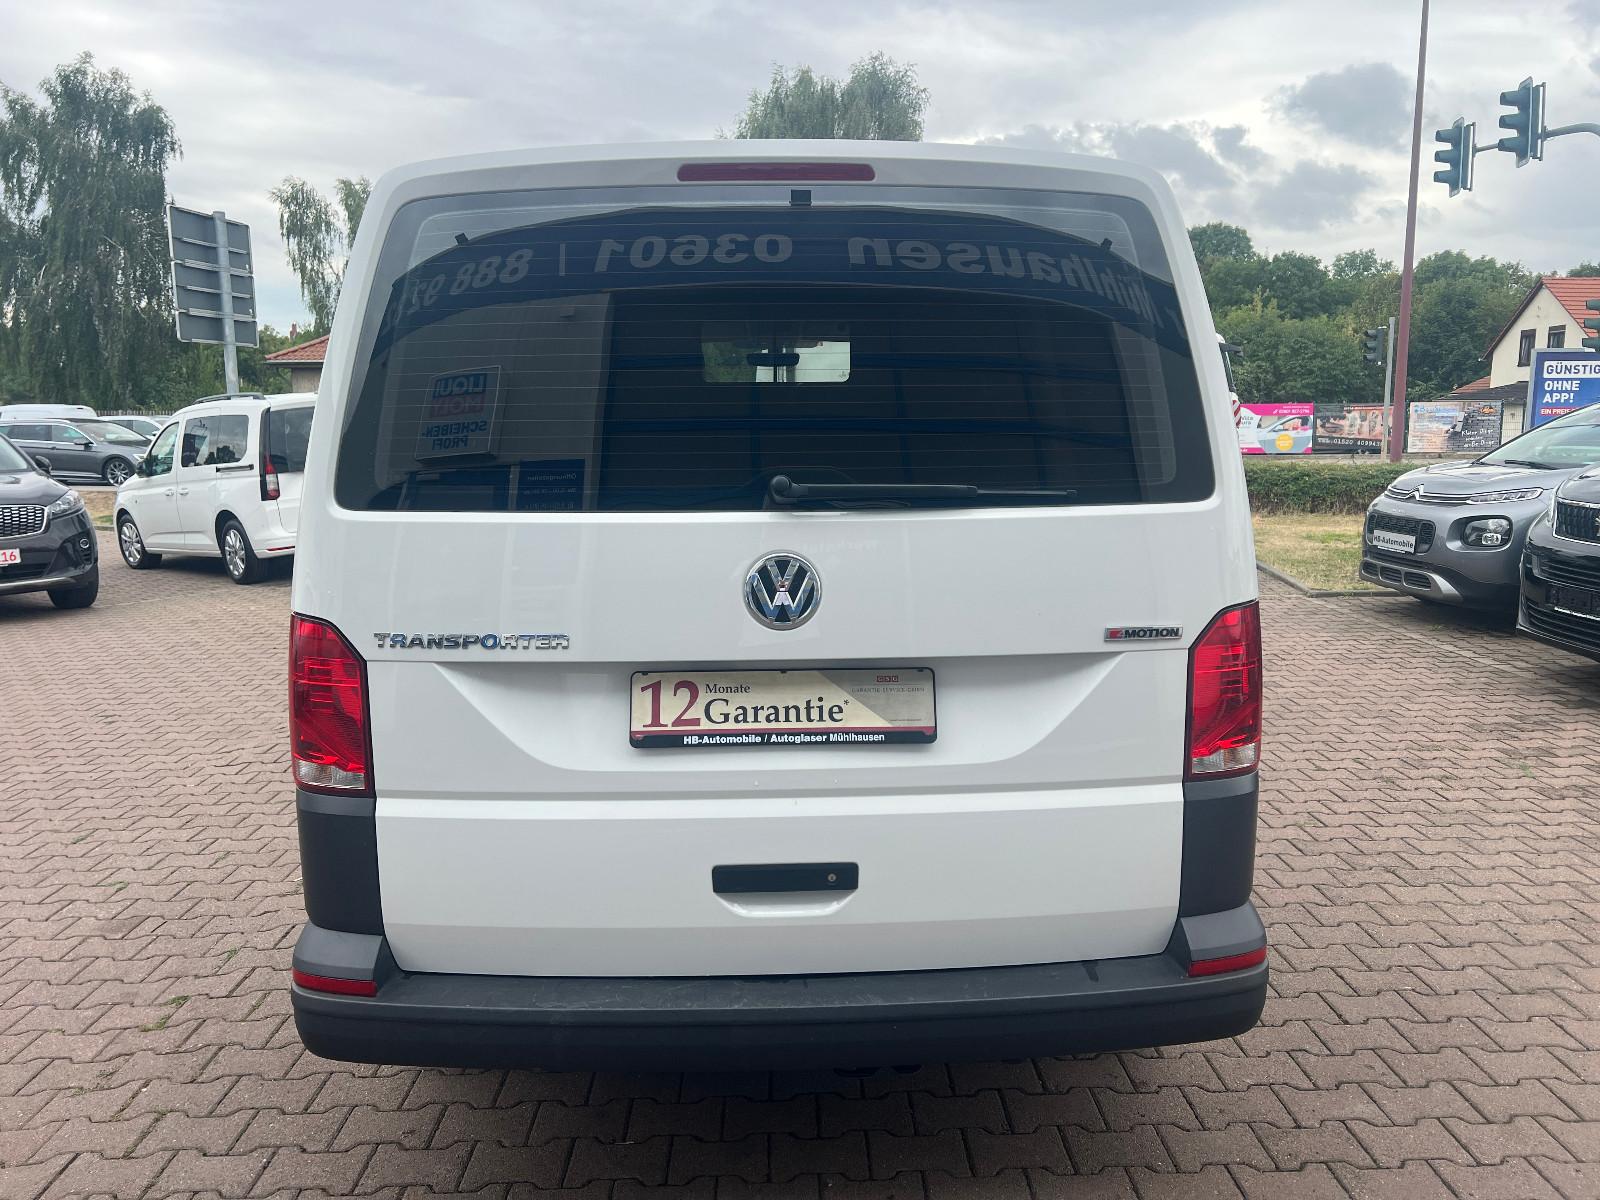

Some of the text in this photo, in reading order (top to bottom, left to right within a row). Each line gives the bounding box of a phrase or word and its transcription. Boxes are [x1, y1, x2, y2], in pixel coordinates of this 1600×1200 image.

[1546, 362, 1600, 375] GÜNSTIG
[1544, 380, 1580, 391] OHNE
[1543, 392, 1574, 403] APP!
[374, 632, 570, 650] TRANSPORTER
[640, 679, 750, 728] 12 Monate
[683, 735, 762, 745] HB-Automobile
[770, 733, 827, 744] Autoglaser
[829, 732, 885, 742] Mühlhausen
